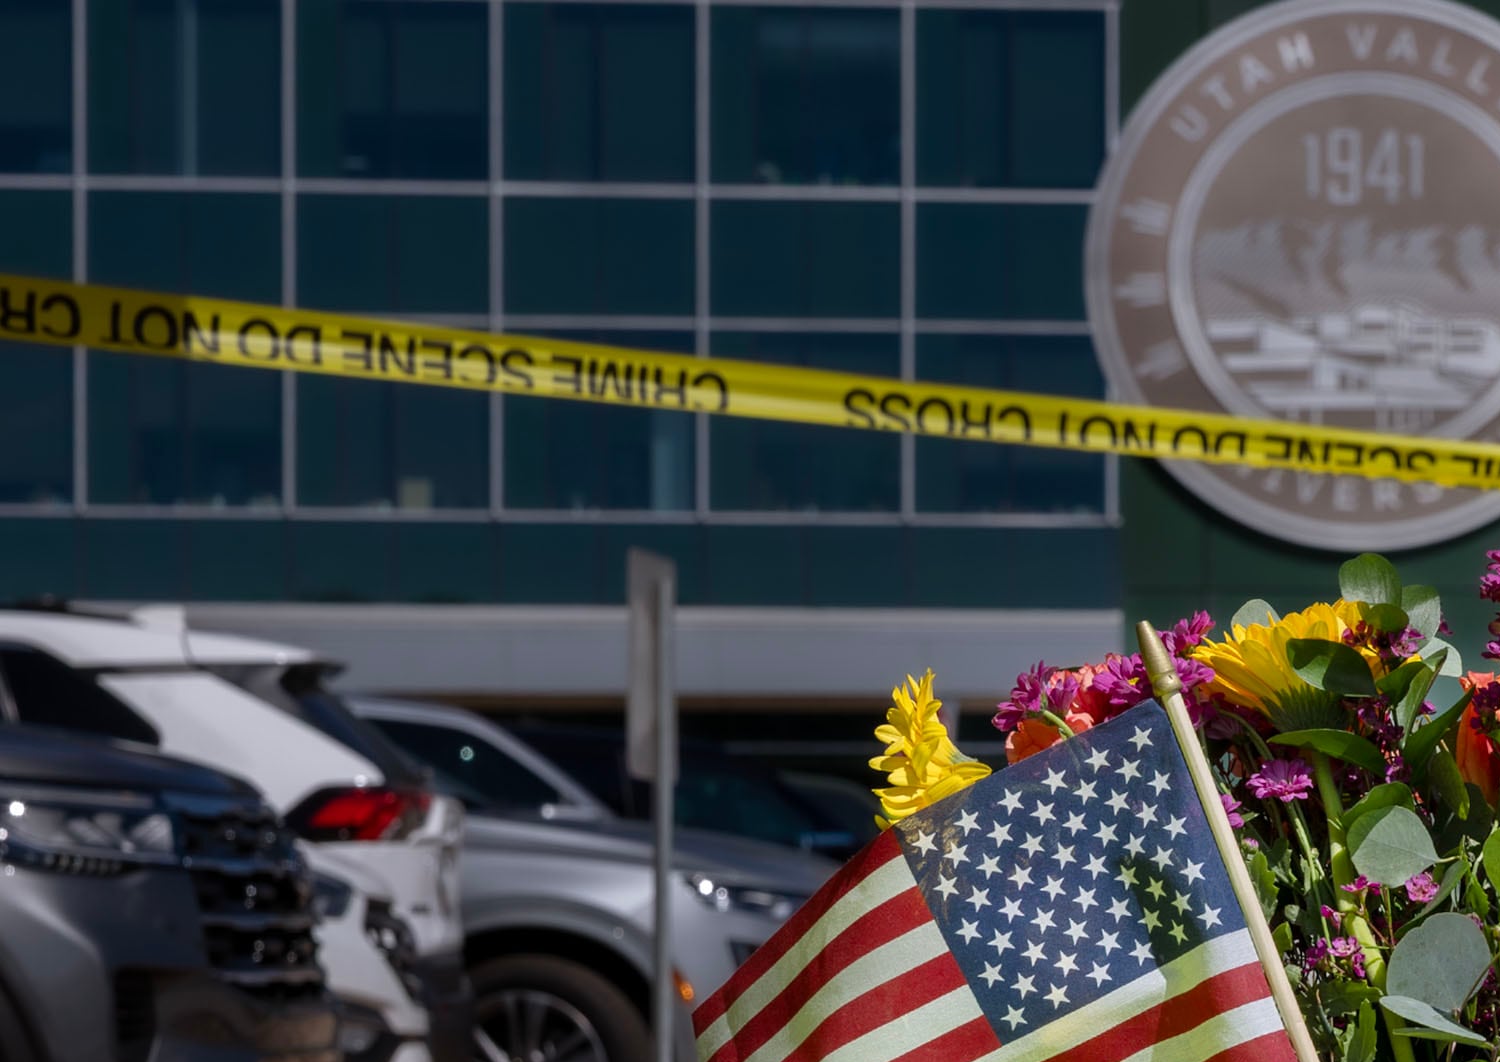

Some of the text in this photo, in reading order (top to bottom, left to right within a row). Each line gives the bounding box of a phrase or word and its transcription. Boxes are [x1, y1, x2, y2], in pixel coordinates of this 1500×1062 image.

[1169, 33, 1315, 143] UTAH
[1303, 127, 1425, 206] 1941
[100, 300, 222, 357] NOT
[237, 318, 323, 366] DO
[342, 330, 535, 390] SCENE
[552, 355, 731, 413] CRIME
[843, 387, 1033, 439] CROSS
